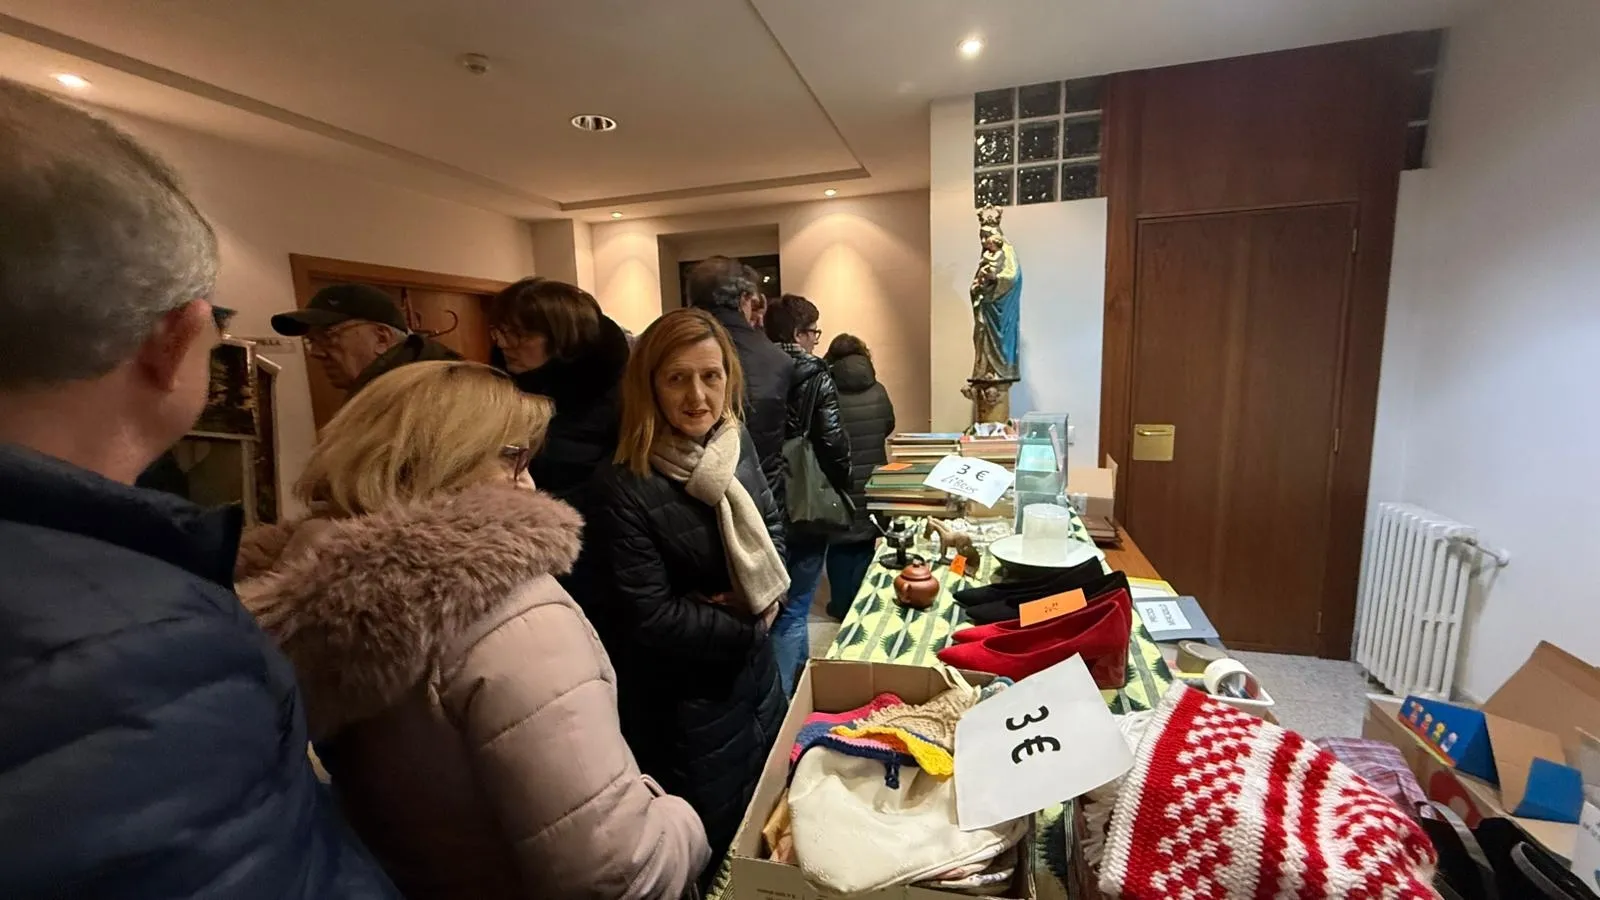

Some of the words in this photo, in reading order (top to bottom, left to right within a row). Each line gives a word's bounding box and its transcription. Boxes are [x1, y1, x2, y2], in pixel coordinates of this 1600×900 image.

[957, 464, 971, 475] 3
[975, 470, 990, 481] €
[1005, 705, 1050, 731] 3
